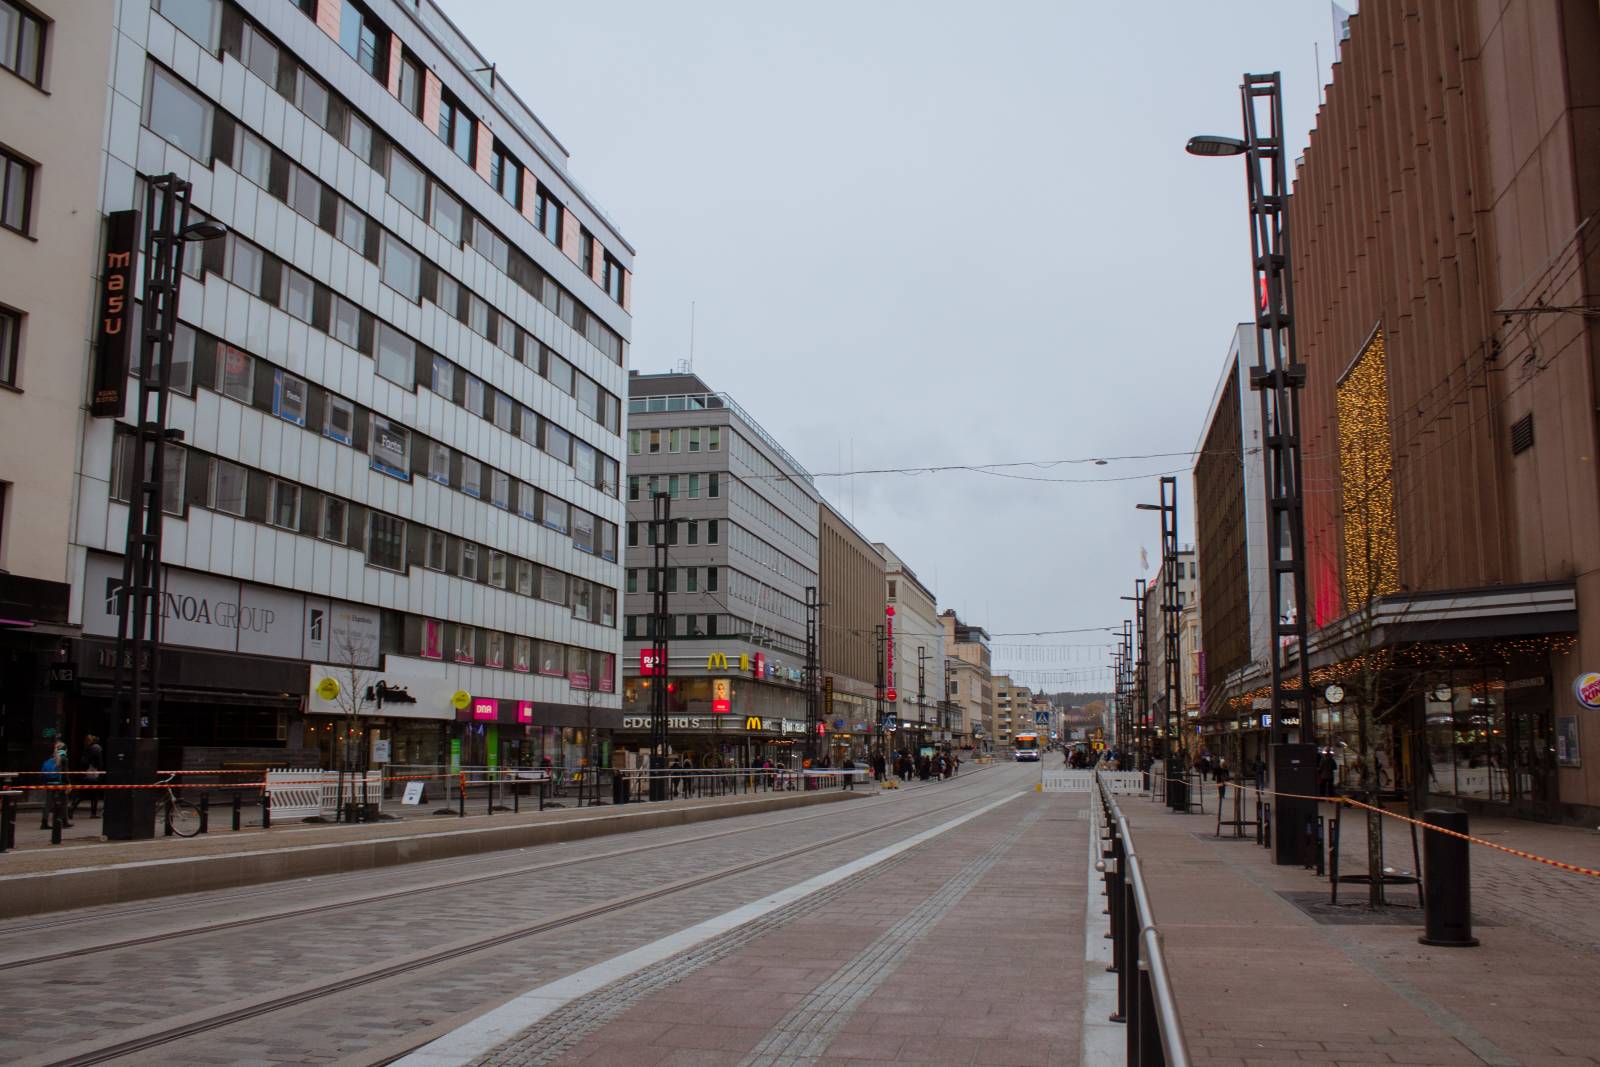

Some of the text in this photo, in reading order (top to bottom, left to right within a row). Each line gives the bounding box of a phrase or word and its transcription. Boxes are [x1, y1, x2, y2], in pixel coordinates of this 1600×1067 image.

[104, 250, 130, 335] masu
[158, 590, 275, 635] NOA GROUP
[476, 704, 492, 714] DNA
